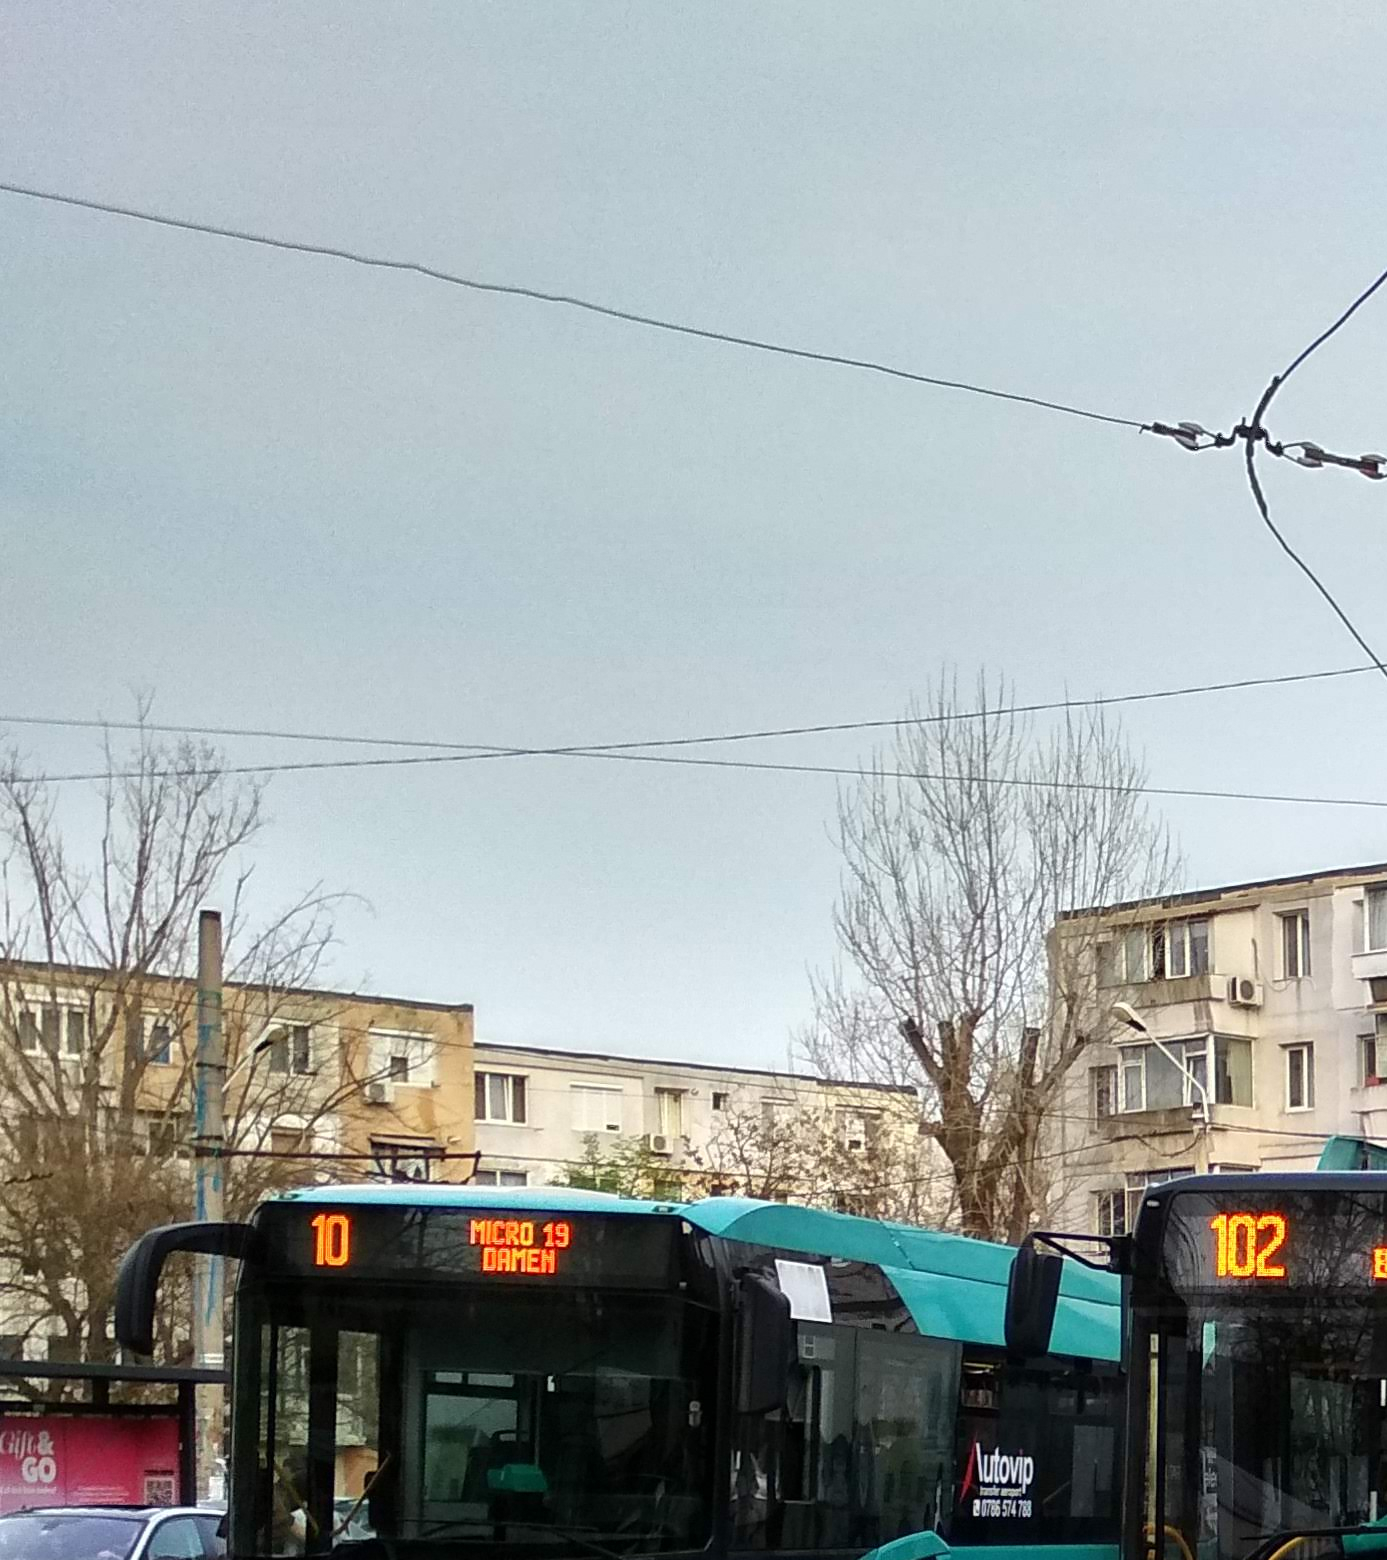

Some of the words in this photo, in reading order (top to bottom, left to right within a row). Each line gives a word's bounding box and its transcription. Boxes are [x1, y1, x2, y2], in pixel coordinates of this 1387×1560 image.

[312, 1214, 349, 1267] 10
[470, 1220, 534, 1247] MICRO
[543, 1223, 570, 1248] 19
[1210, 1213, 1287, 1278] 102
[482, 1248, 557, 1274] DAMEN
[22, 1456, 57, 1484] GO
[960, 1436, 1034, 1502] Autovip
